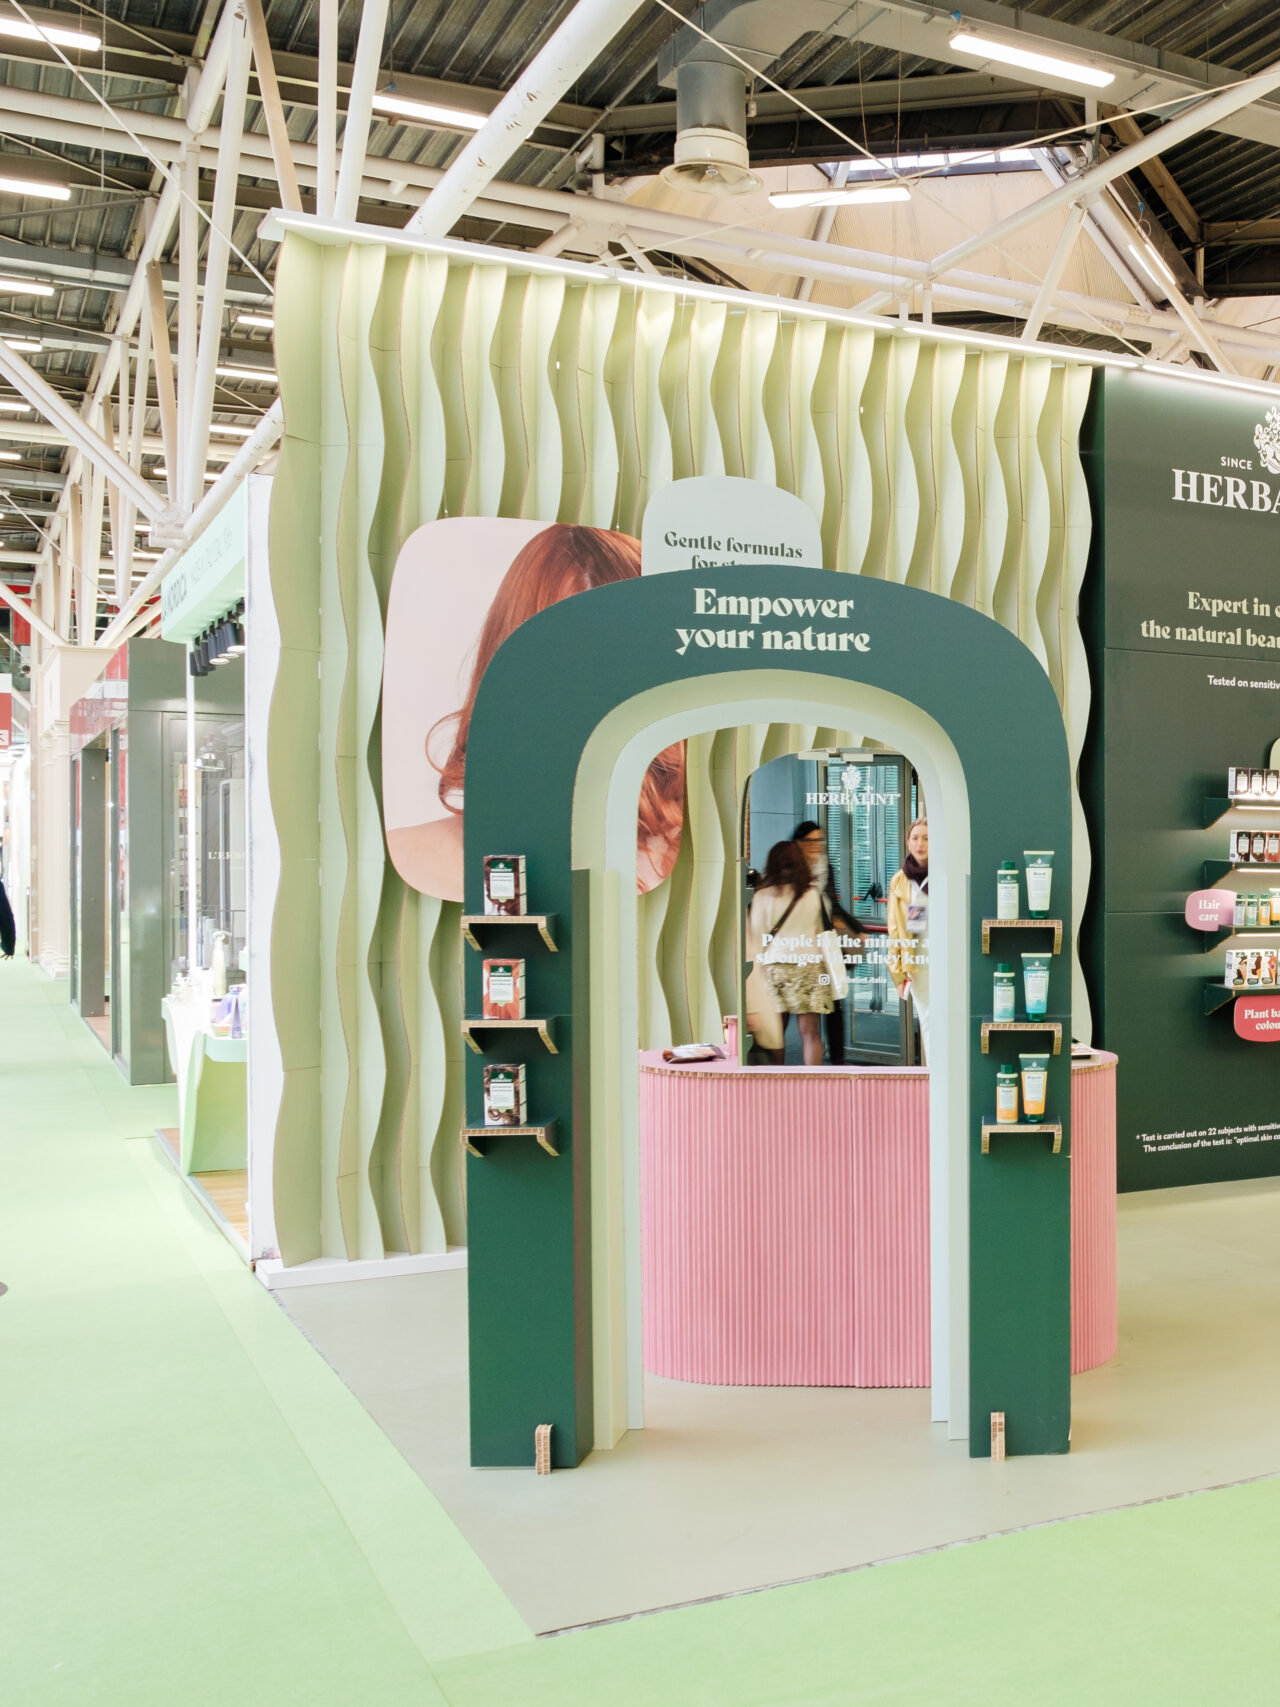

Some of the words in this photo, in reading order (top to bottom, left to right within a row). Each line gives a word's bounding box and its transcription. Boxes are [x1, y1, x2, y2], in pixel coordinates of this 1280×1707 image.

[1220, 456, 1252, 470] SINCE
[664, 531, 722, 551] Gentle
[726, 536, 803, 559] formulas
[693, 587, 855, 625] Empower
[1187, 591, 1250, 617] Expert
[1252, 598, 1271, 617] in
[674, 628, 755, 656] your
[761, 626, 872, 652] nature
[1140, 620, 1171, 640] the
[1175, 626, 1242, 646] natural
[1207, 675, 1236, 688] Tested
[1237, 680, 1249, 688] on
[1198, 900, 1220, 910] Hair
[1198, 912, 1219, 921] care
[761, 934, 812, 952] People
[837, 934, 862, 948] the
[864, 934, 919, 948] mirror
[1244, 1008, 1270, 1020] Plant
[1141, 1134, 1156, 1142] Test
[1163, 1130, 1186, 1140] carried
[1186, 1130, 1198, 1138] out
[1208, 1128, 1217, 1136] 22
[1218, 1126, 1242, 1136] subjects
[1243, 1124, 1256, 1132] with
[1143, 1144, 1156, 1152] The
[1158, 1142, 1192, 1152] conclusion
[1192, 1140, 1200, 1148] of
[1200, 1139, 1212, 1147] the
[1212, 1138, 1224, 1146] test
[1260, 1134, 1272, 1142] skin
